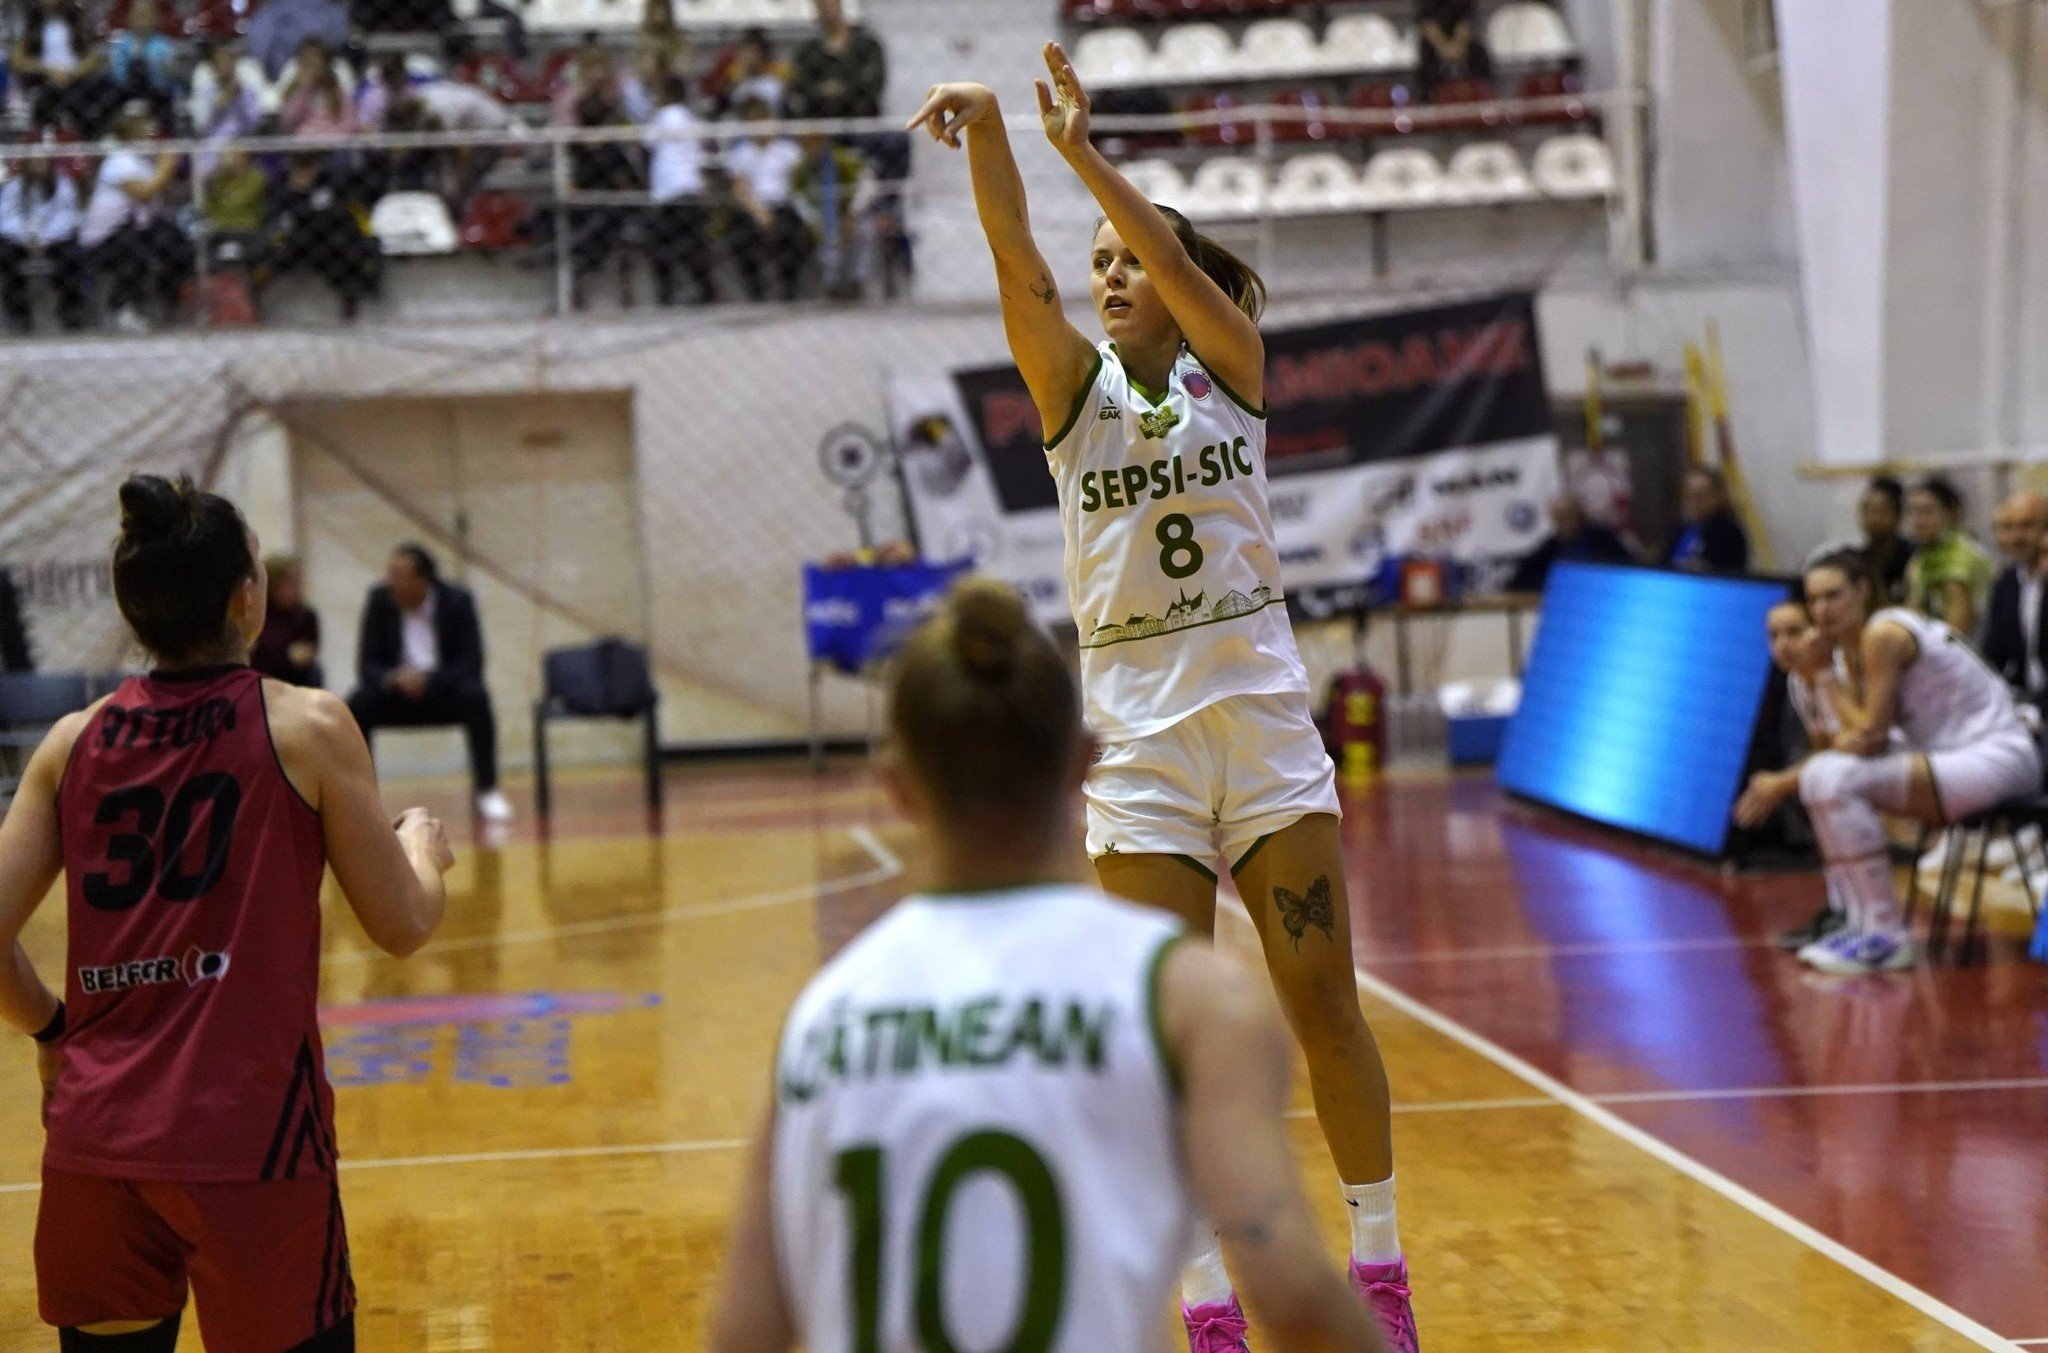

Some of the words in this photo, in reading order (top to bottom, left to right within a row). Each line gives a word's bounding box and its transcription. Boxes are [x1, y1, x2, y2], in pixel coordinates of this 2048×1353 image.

[1081, 436, 1254, 512] SEPSI-SIC
[1155, 513, 1203, 579] 8
[82, 772, 241, 911] 30
[830, 1126, 1069, 1353] 10
